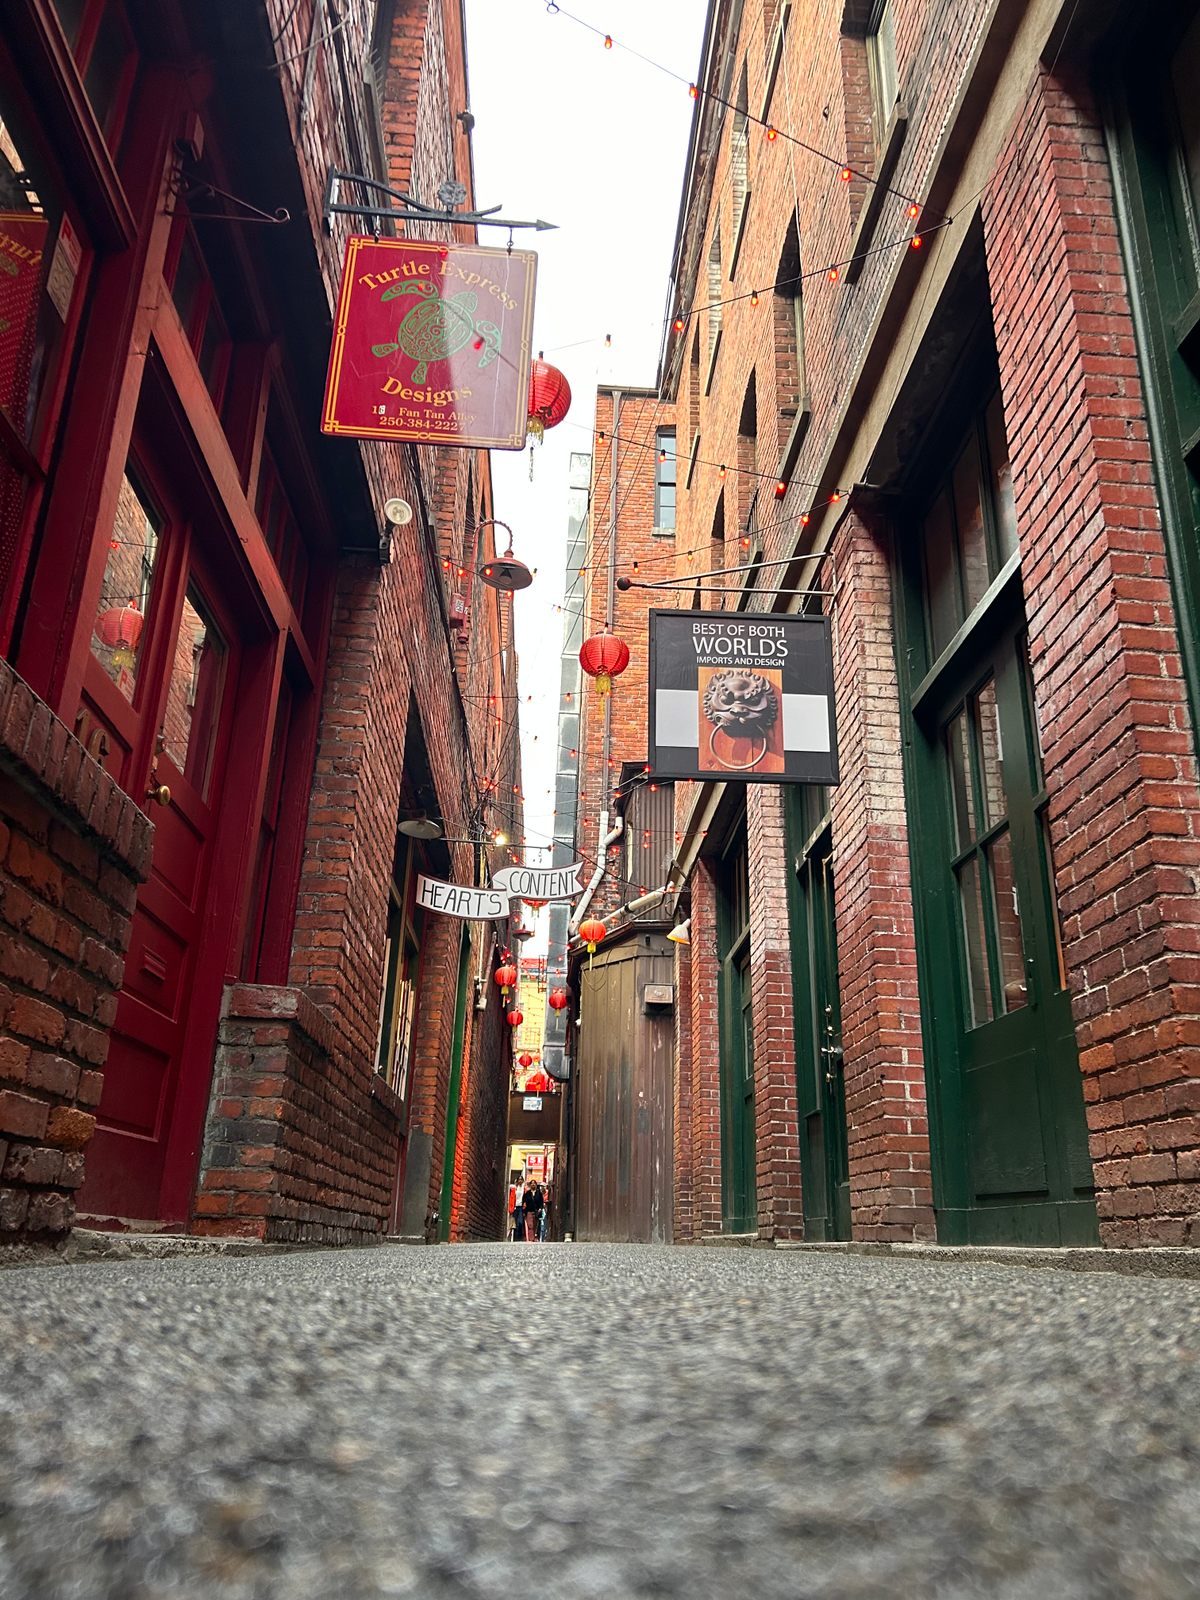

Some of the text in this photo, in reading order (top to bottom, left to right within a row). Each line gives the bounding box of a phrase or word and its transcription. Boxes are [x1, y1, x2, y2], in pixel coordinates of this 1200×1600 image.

[358, 260, 518, 310] Turtle Express
[380, 376, 472, 407] Designs
[379, 416, 466, 431] 250-384-2227
[399, 407, 420, 417] Fan
[423, 409, 445, 420] Tan
[448, 411, 477, 424] Alley
[692, 623, 785, 638] BEST OF BOTH
[692, 636, 788, 657] WORLDS
[696, 656, 785, 667] IMPORTS AND DESIGN
[421, 869, 576, 916] HEART'S CONTENT
